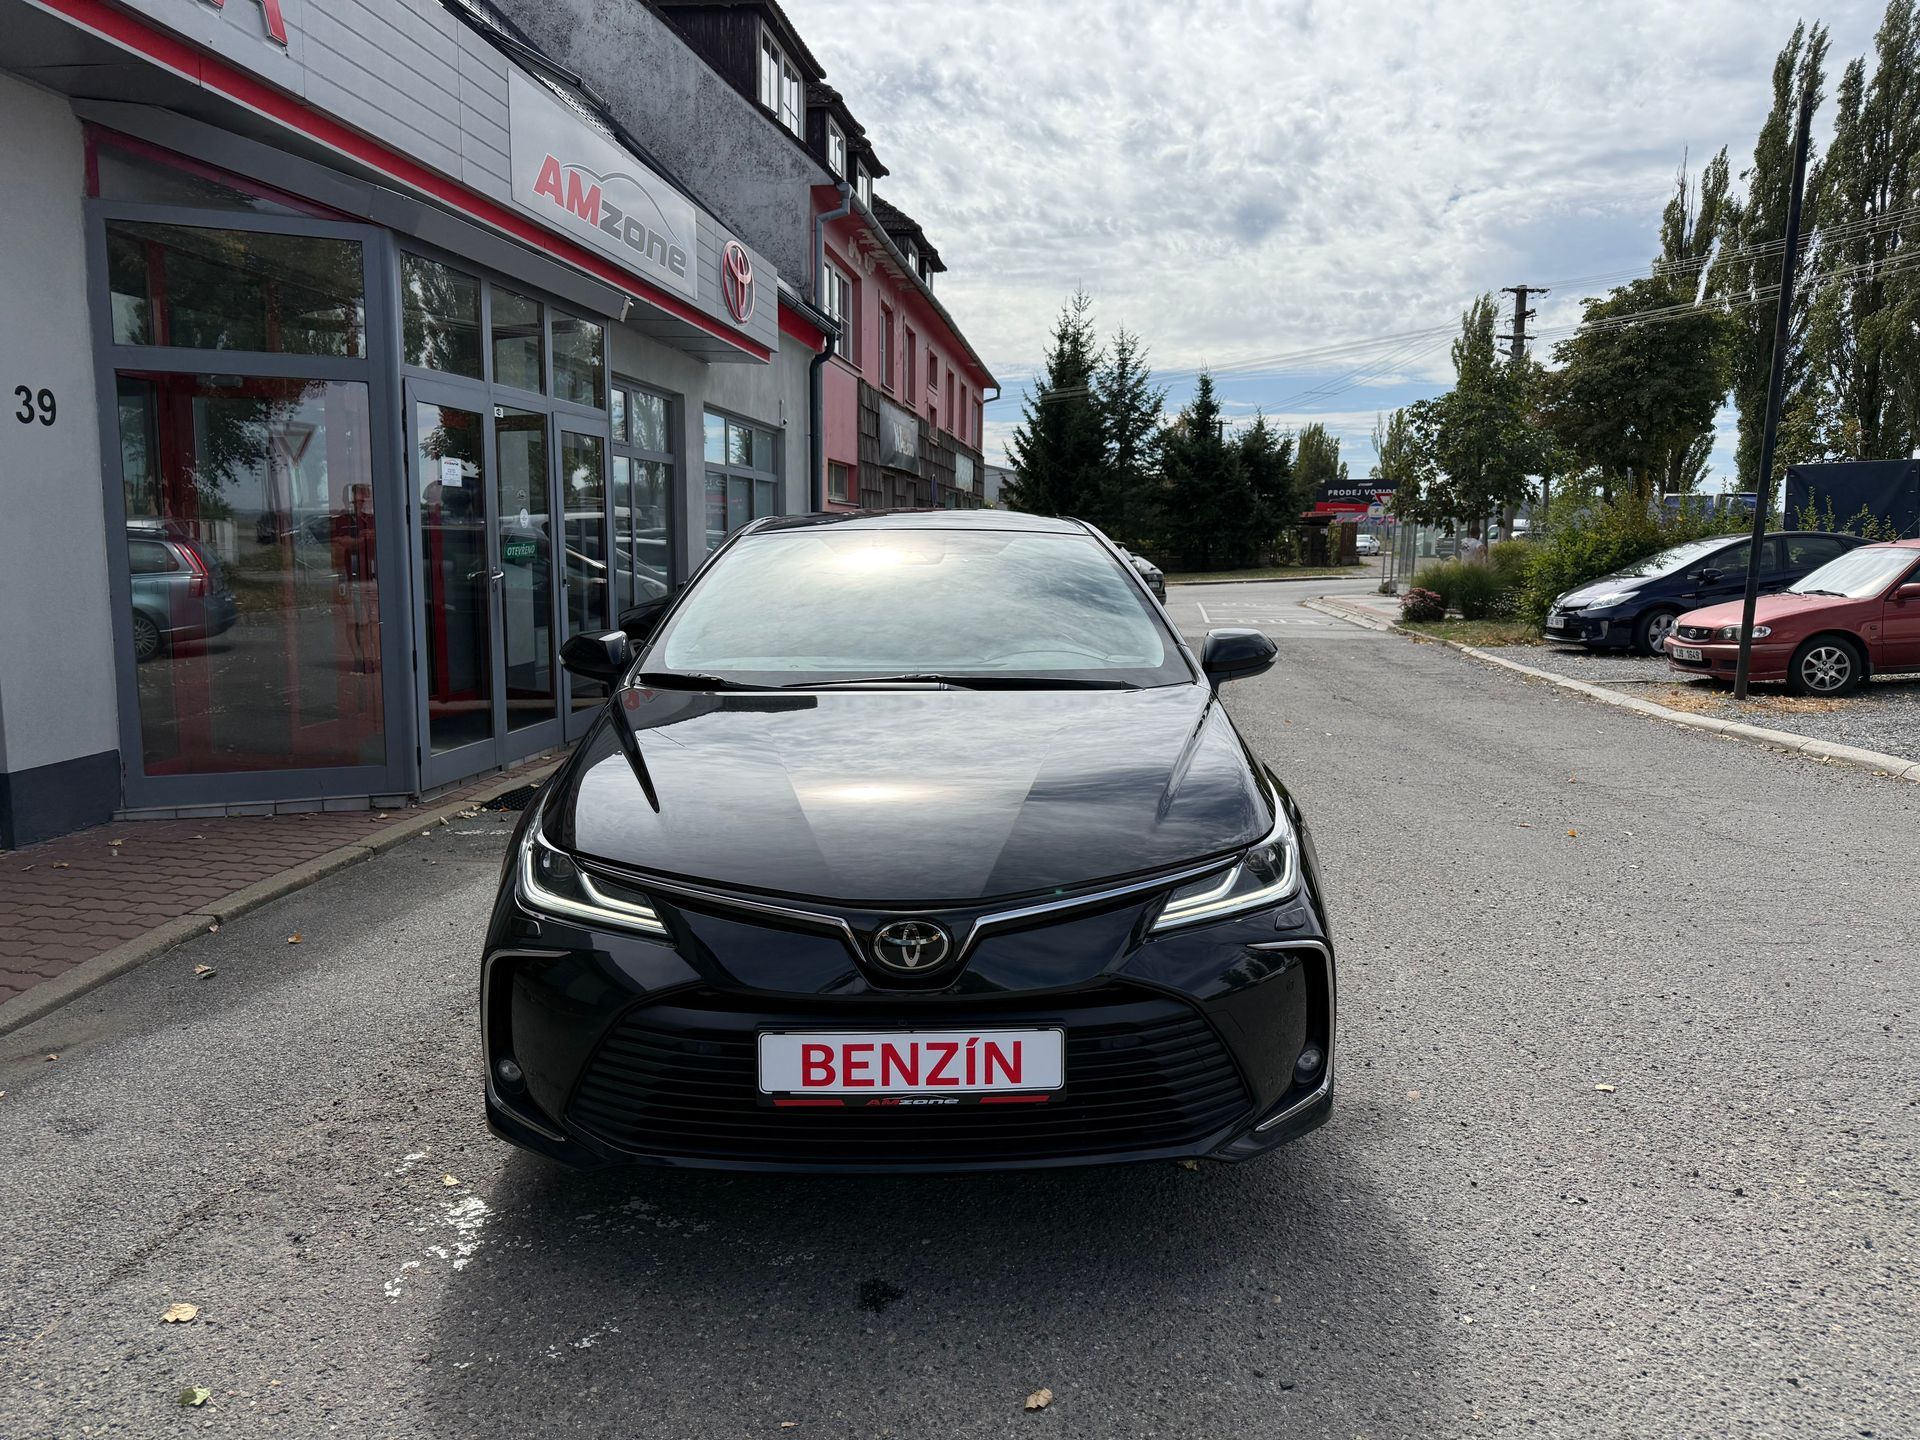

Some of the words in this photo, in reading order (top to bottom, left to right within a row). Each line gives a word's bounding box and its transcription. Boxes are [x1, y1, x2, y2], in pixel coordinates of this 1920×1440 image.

[533, 153, 687, 278] AMzone
[14, 384, 57, 427] 39
[1327, 488, 1362, 496] PRODEJ
[801, 1036, 1022, 1087] BENZÍN
[864, 1097, 960, 1106] AMzone
